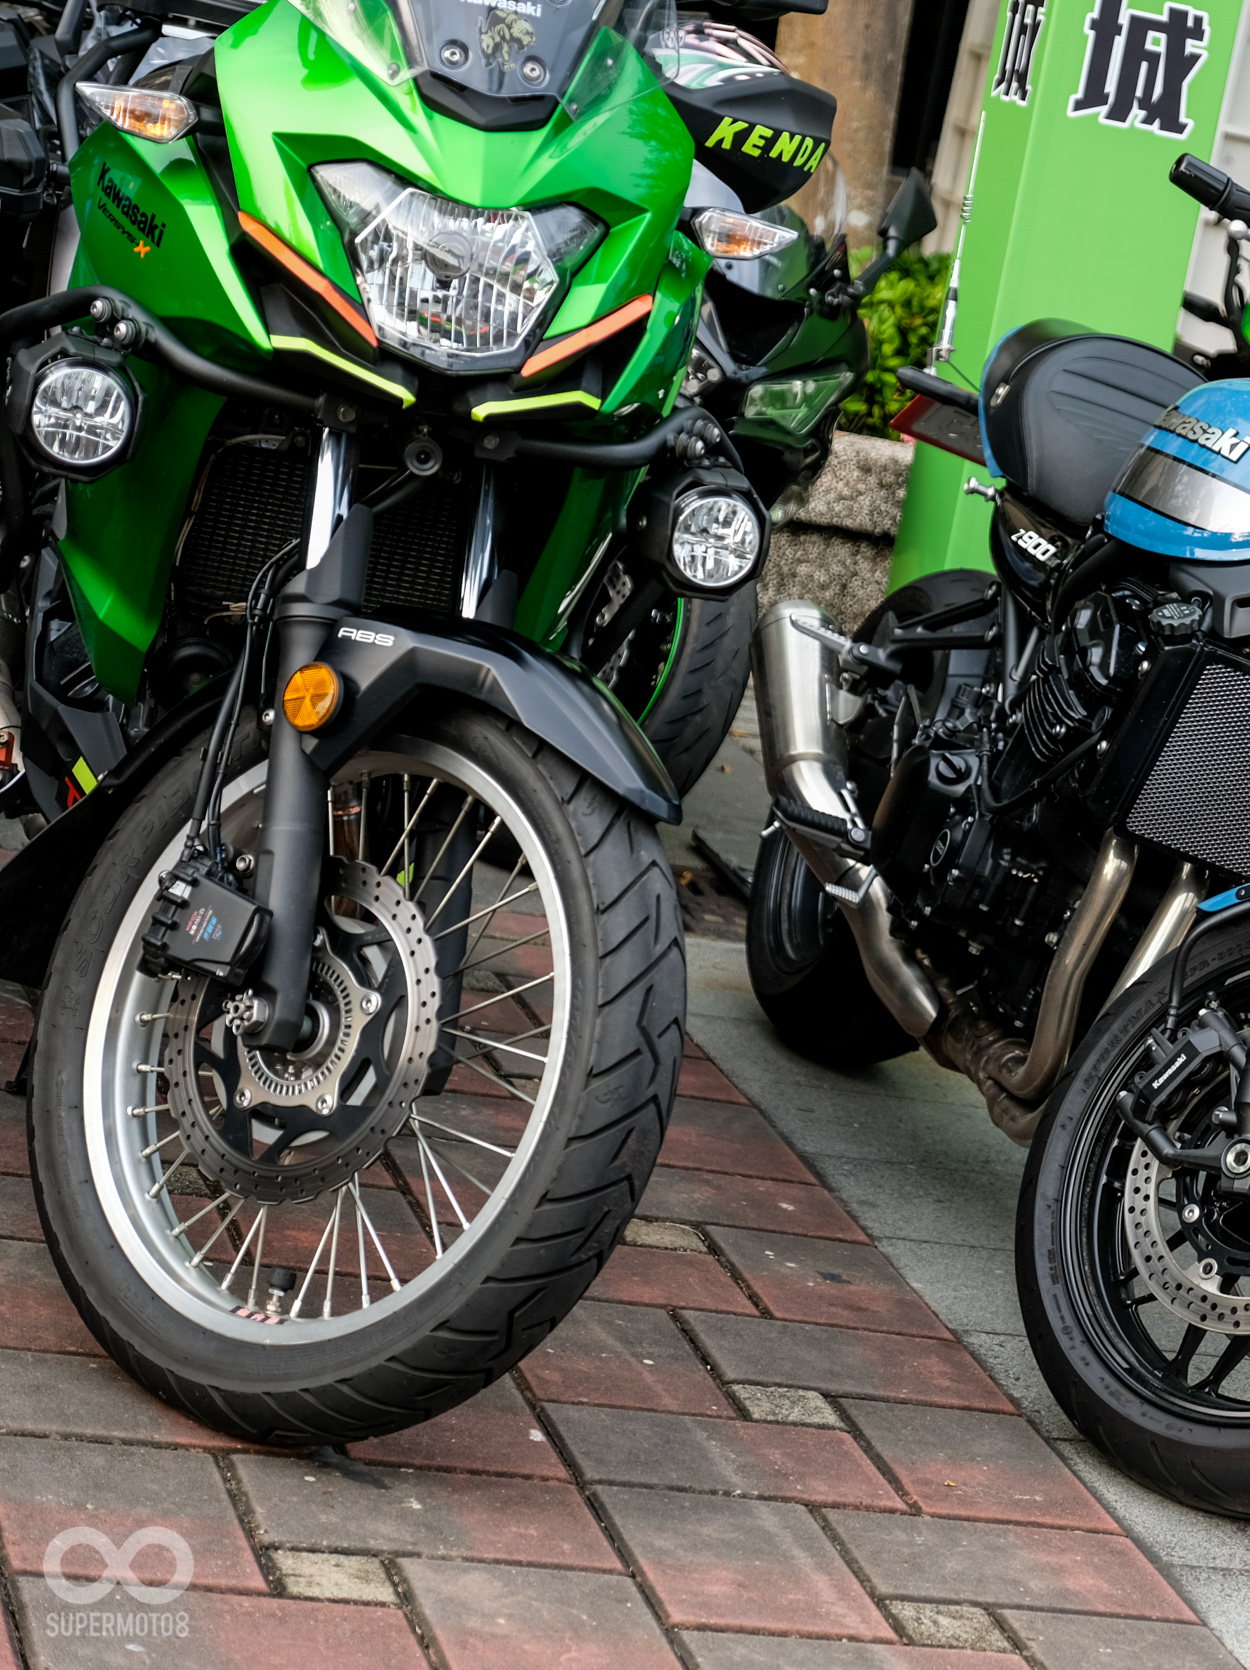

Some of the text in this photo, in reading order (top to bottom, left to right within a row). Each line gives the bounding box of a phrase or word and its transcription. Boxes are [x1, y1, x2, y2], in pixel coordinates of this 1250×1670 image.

[704, 116, 826, 173] KENDA
[97, 161, 166, 248] Kawasaki
[97, 197, 151, 259] VERSYS-X
[337, 627, 395, 647] ABS
[1152, 1053, 1187, 1090] Kawasaki
